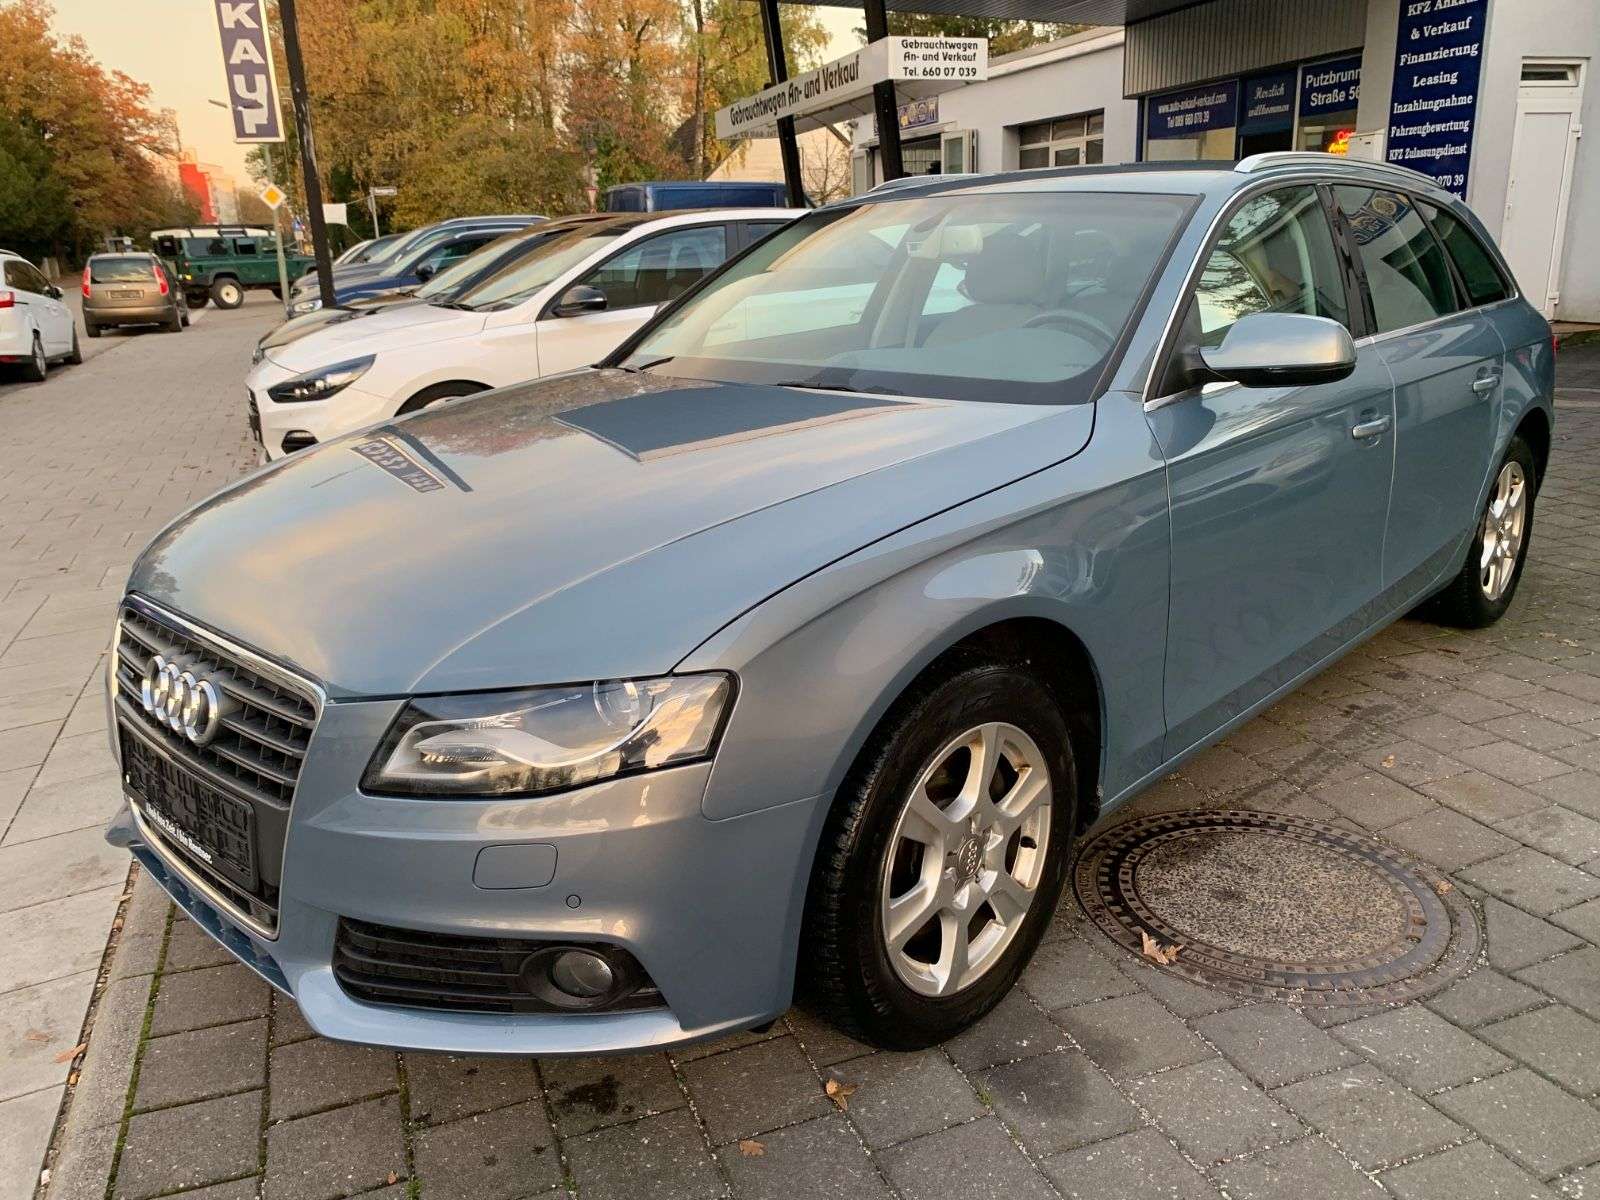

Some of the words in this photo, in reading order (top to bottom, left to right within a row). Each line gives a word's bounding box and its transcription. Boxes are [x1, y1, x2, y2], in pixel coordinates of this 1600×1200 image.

[1407, 1, 1431, 17] KFZ
[1433, 0, 1478, 11] Anka
[1410, 28, 1420, 40] &
[1423, 16, 1472, 38] Verkauf
[901, 39, 978, 51] Gebrauchtwagen
[903, 51, 920, 62] An-
[922, 52, 939, 62] und
[942, 52, 977, 62] Verkauf
[1399, 43, 1479, 66] Finanzierung
[922, 67, 940, 77] 660
[943, 67, 955, 77] 07
[958, 67, 977, 77] 039
[1412, 71, 1459, 88] Leasing
[730, 91, 787, 126] Gebrauchtwagen
[788, 82, 802, 107] An-
[804, 71, 820, 99] und
[822, 54, 859, 91] Verkauf
[1309, 88, 1346, 107] Straße
[1393, 94, 1473, 114] Inzahlungnahme
[1391, 120, 1470, 137] Fahrzeugbewertung
[1389, 149, 1403, 160] KFZ
[1404, 143, 1467, 159] Zulassungsdienst
[1453, 174, 1464, 186] 39
